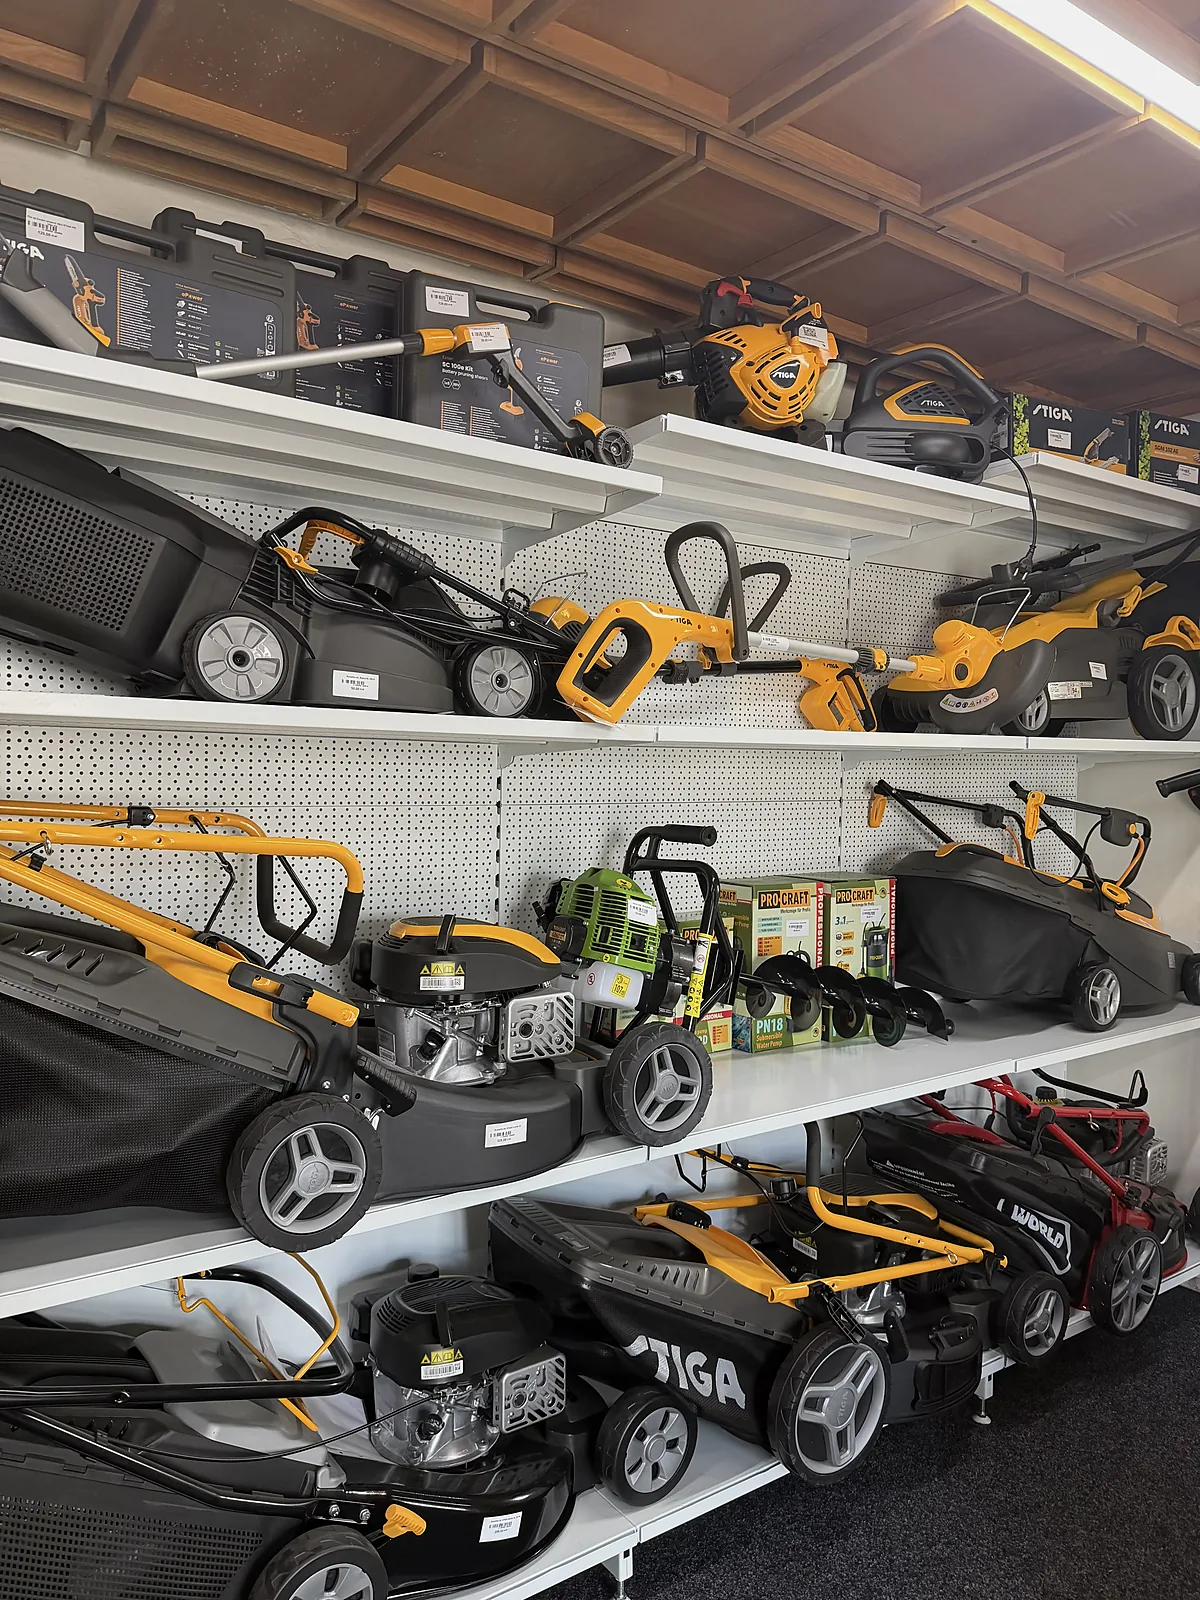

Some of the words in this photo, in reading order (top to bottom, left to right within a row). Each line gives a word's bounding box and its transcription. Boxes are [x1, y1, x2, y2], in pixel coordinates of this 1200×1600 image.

[3, 239, 45, 261] IGA
[457, 371, 474, 379] pruning
[773, 371, 796, 379] STIGA
[920, 399, 945, 407] STIGA
[1032, 404, 1073, 422] STIGA
[1154, 419, 1190, 436] STIGA
[670, 617, 693, 626] TIGA
[756, 1018, 783, 1034] PN18
[756, 1032, 783, 1042] Submersible
[756, 1042, 770, 1050] Water
[1010, 1204, 1065, 1249] WORLD
[624, 1335, 746, 1409] STIGA
